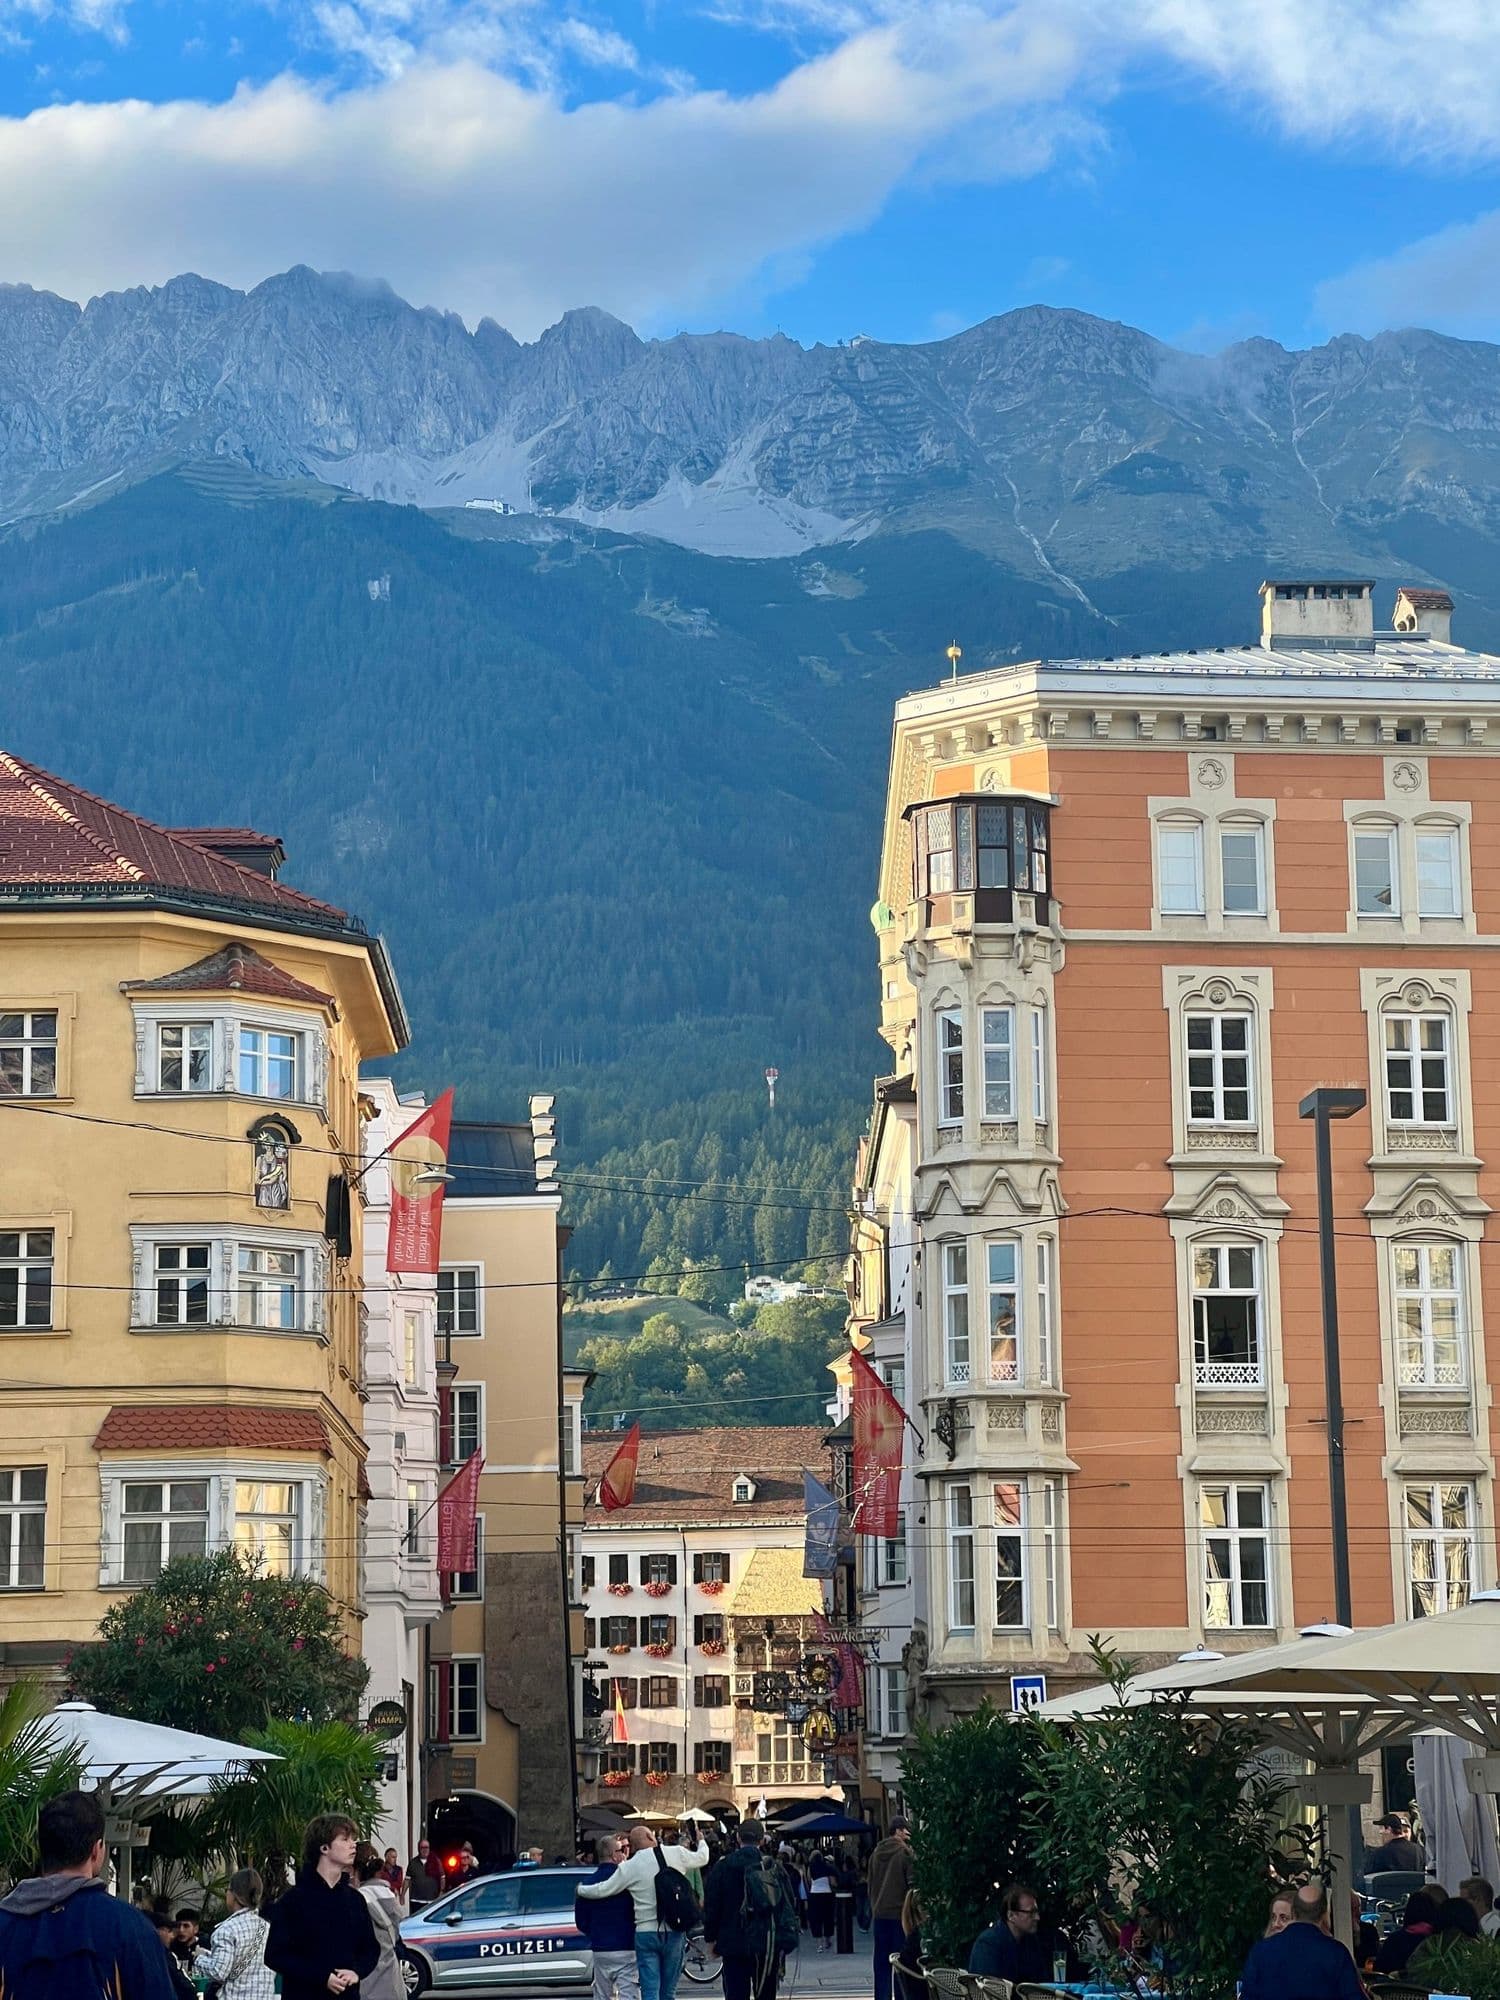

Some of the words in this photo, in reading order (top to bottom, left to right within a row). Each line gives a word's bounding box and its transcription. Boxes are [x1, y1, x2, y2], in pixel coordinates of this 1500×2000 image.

[822, 1629, 890, 1643] SWAROKI
[374, 1716, 403, 1724] HAMPL
[480, 1939, 553, 1957] POLIZEI
